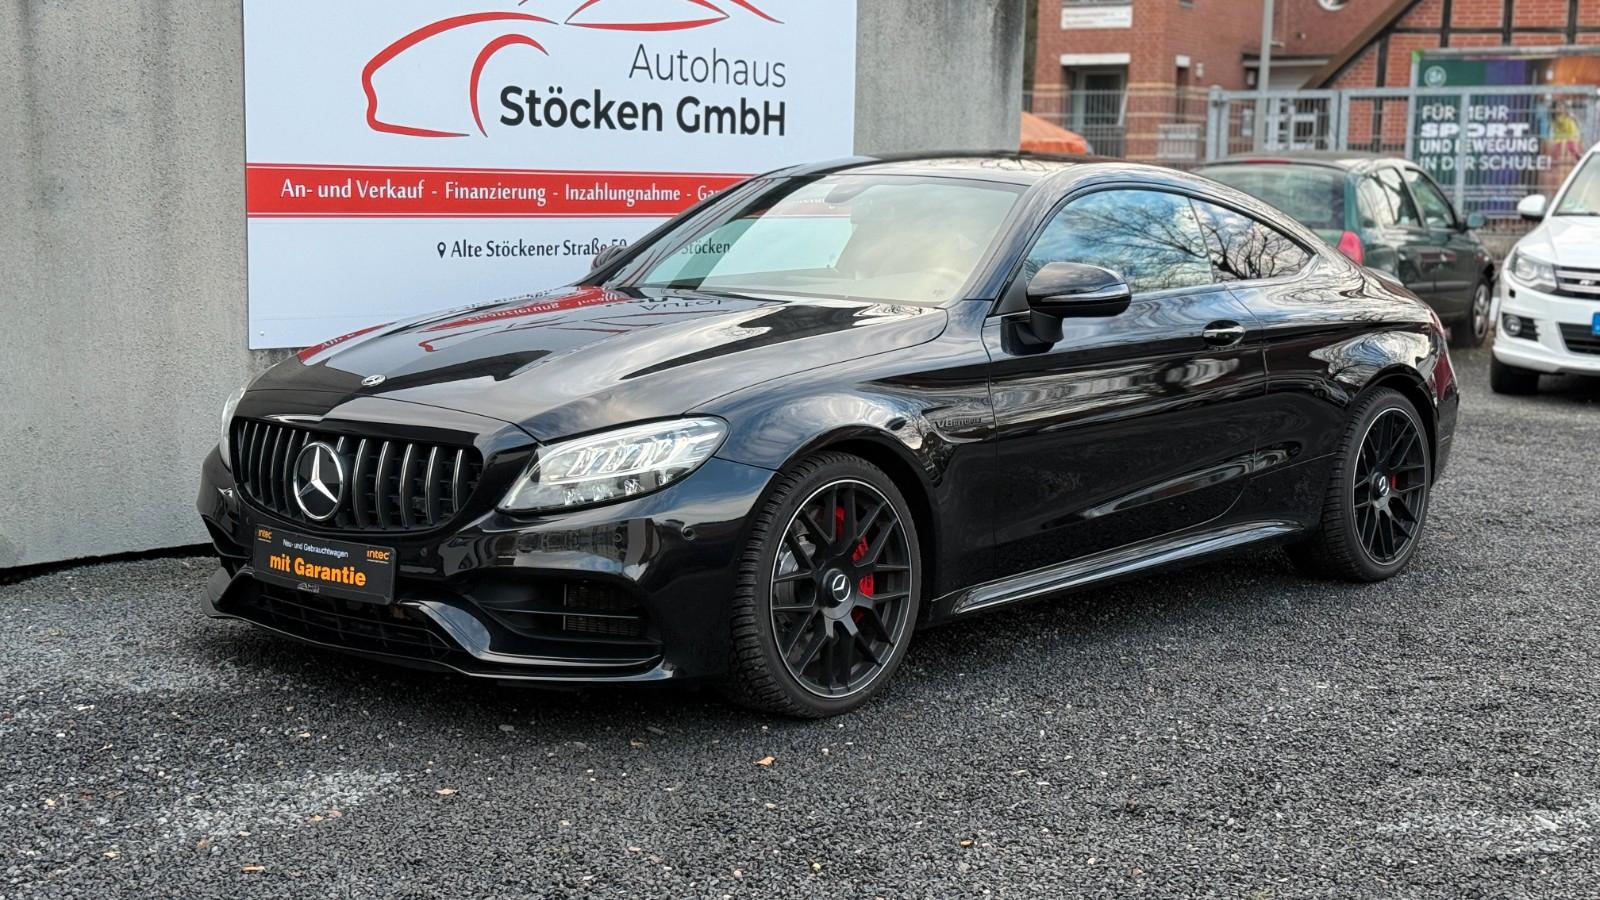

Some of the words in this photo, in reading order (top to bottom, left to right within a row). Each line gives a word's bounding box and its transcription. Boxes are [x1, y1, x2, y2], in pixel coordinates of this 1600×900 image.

[628, 43, 787, 89] Autohaus
[499, 85, 663, 132] Stöcken
[675, 95, 786, 137] GmbH
[1422, 103, 1456, 121] FÜR
[1467, 104, 1508, 121] EHR
[1420, 138, 1453, 154] UND
[1420, 155, 1437, 171] IN
[1441, 155, 1475, 171] DR
[280, 178, 313, 198] An-
[318, 178, 352, 198] und
[356, 179, 425, 199] Verkauf
[445, 181, 546, 207] Finanzierung
[565, 183, 681, 207] Inzahlungnahme
[450, 239, 482, 258] Alte
[486, 239, 560, 257] Stöckener
[563, 237, 607, 256] Straße
[303, 543, 349, 558] Gebrauchtwagen
[269, 553, 291, 573] mit
[294, 556, 367, 587] Garantie
